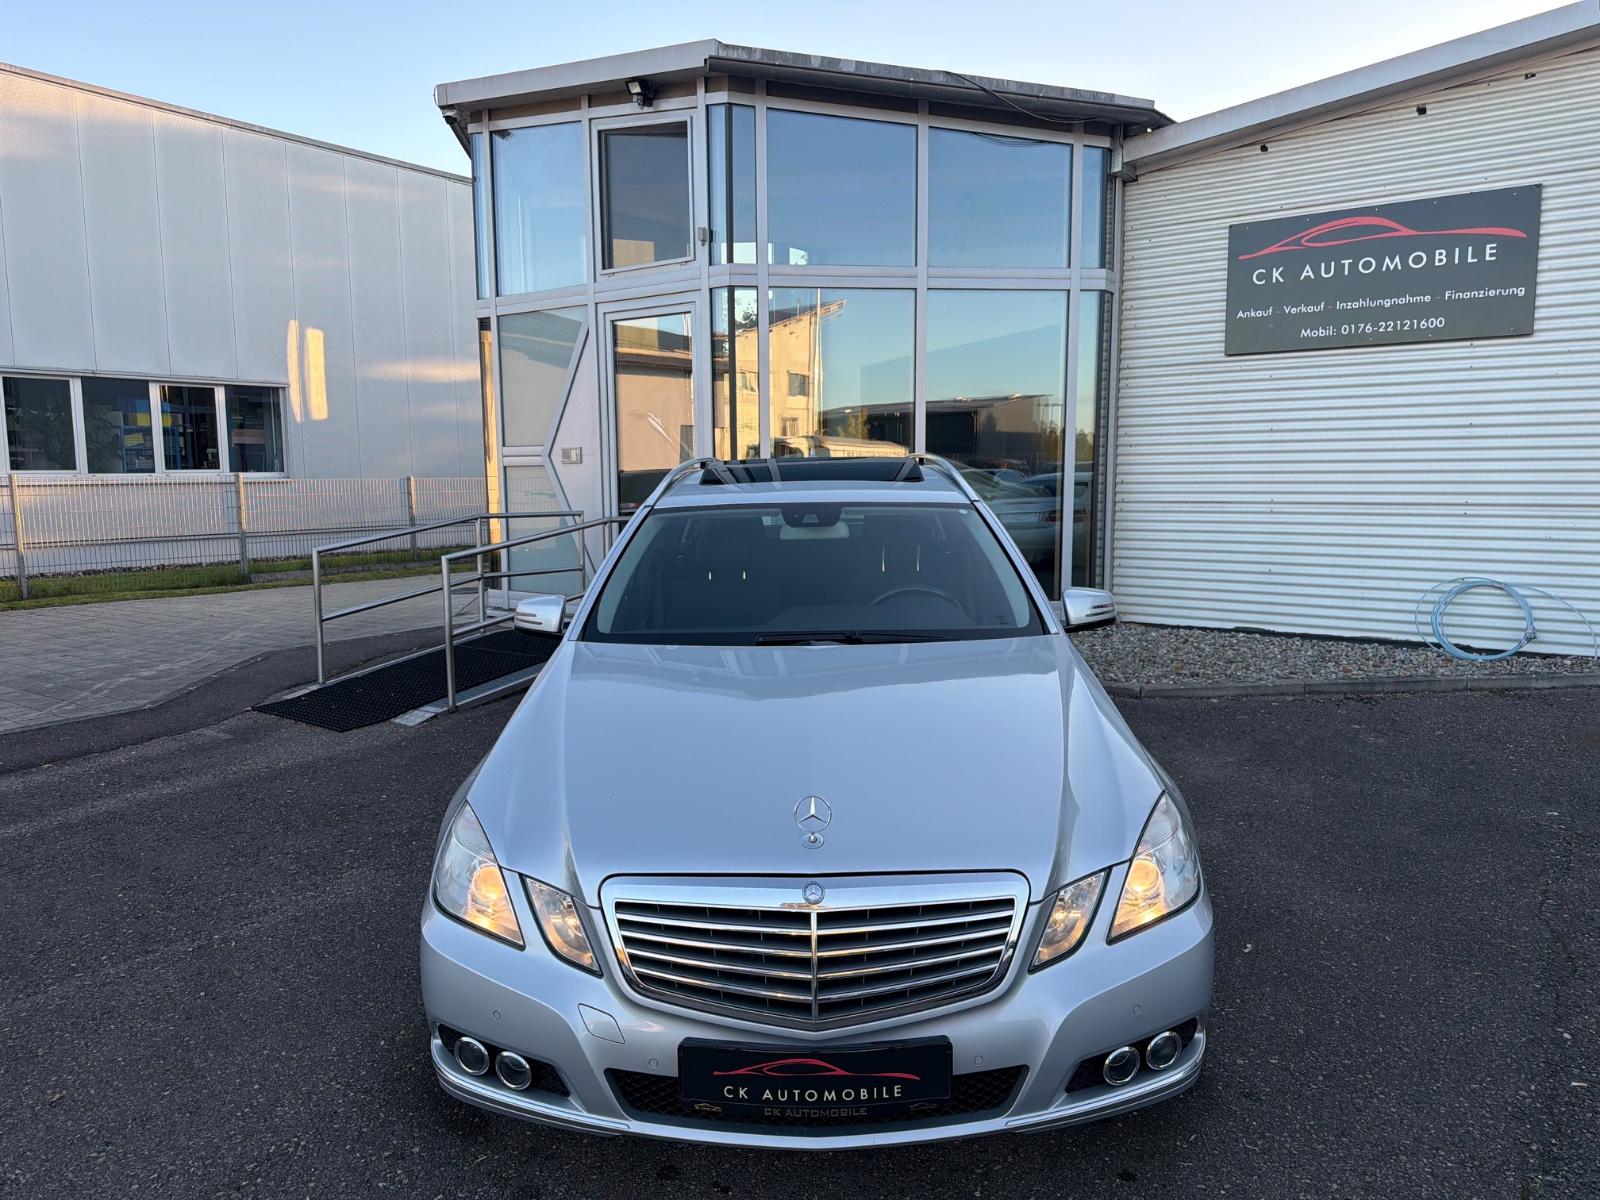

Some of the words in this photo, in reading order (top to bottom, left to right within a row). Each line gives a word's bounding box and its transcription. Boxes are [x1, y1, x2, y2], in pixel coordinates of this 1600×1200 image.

[1252, 266, 1285, 286] CK
[1300, 243, 1498, 281] AUTOMOBILE
[1236, 306, 1273, 319] Ankauf
[1283, 301, 1325, 315] Verkauf
[1336, 294, 1432, 311] Inzahlungnahme
[1445, 286, 1526, 301] Finanzierung
[1300, 325, 1337, 338] Mobil:
[1341, 317, 1446, 335] 0176-22121600
[723, 1085, 749, 1099] CK
[762, 1084, 903, 1102] AUTOMOBILE
[763, 1107, 781, 1118] CK
[784, 1107, 868, 1119] AUTOMOBILE
